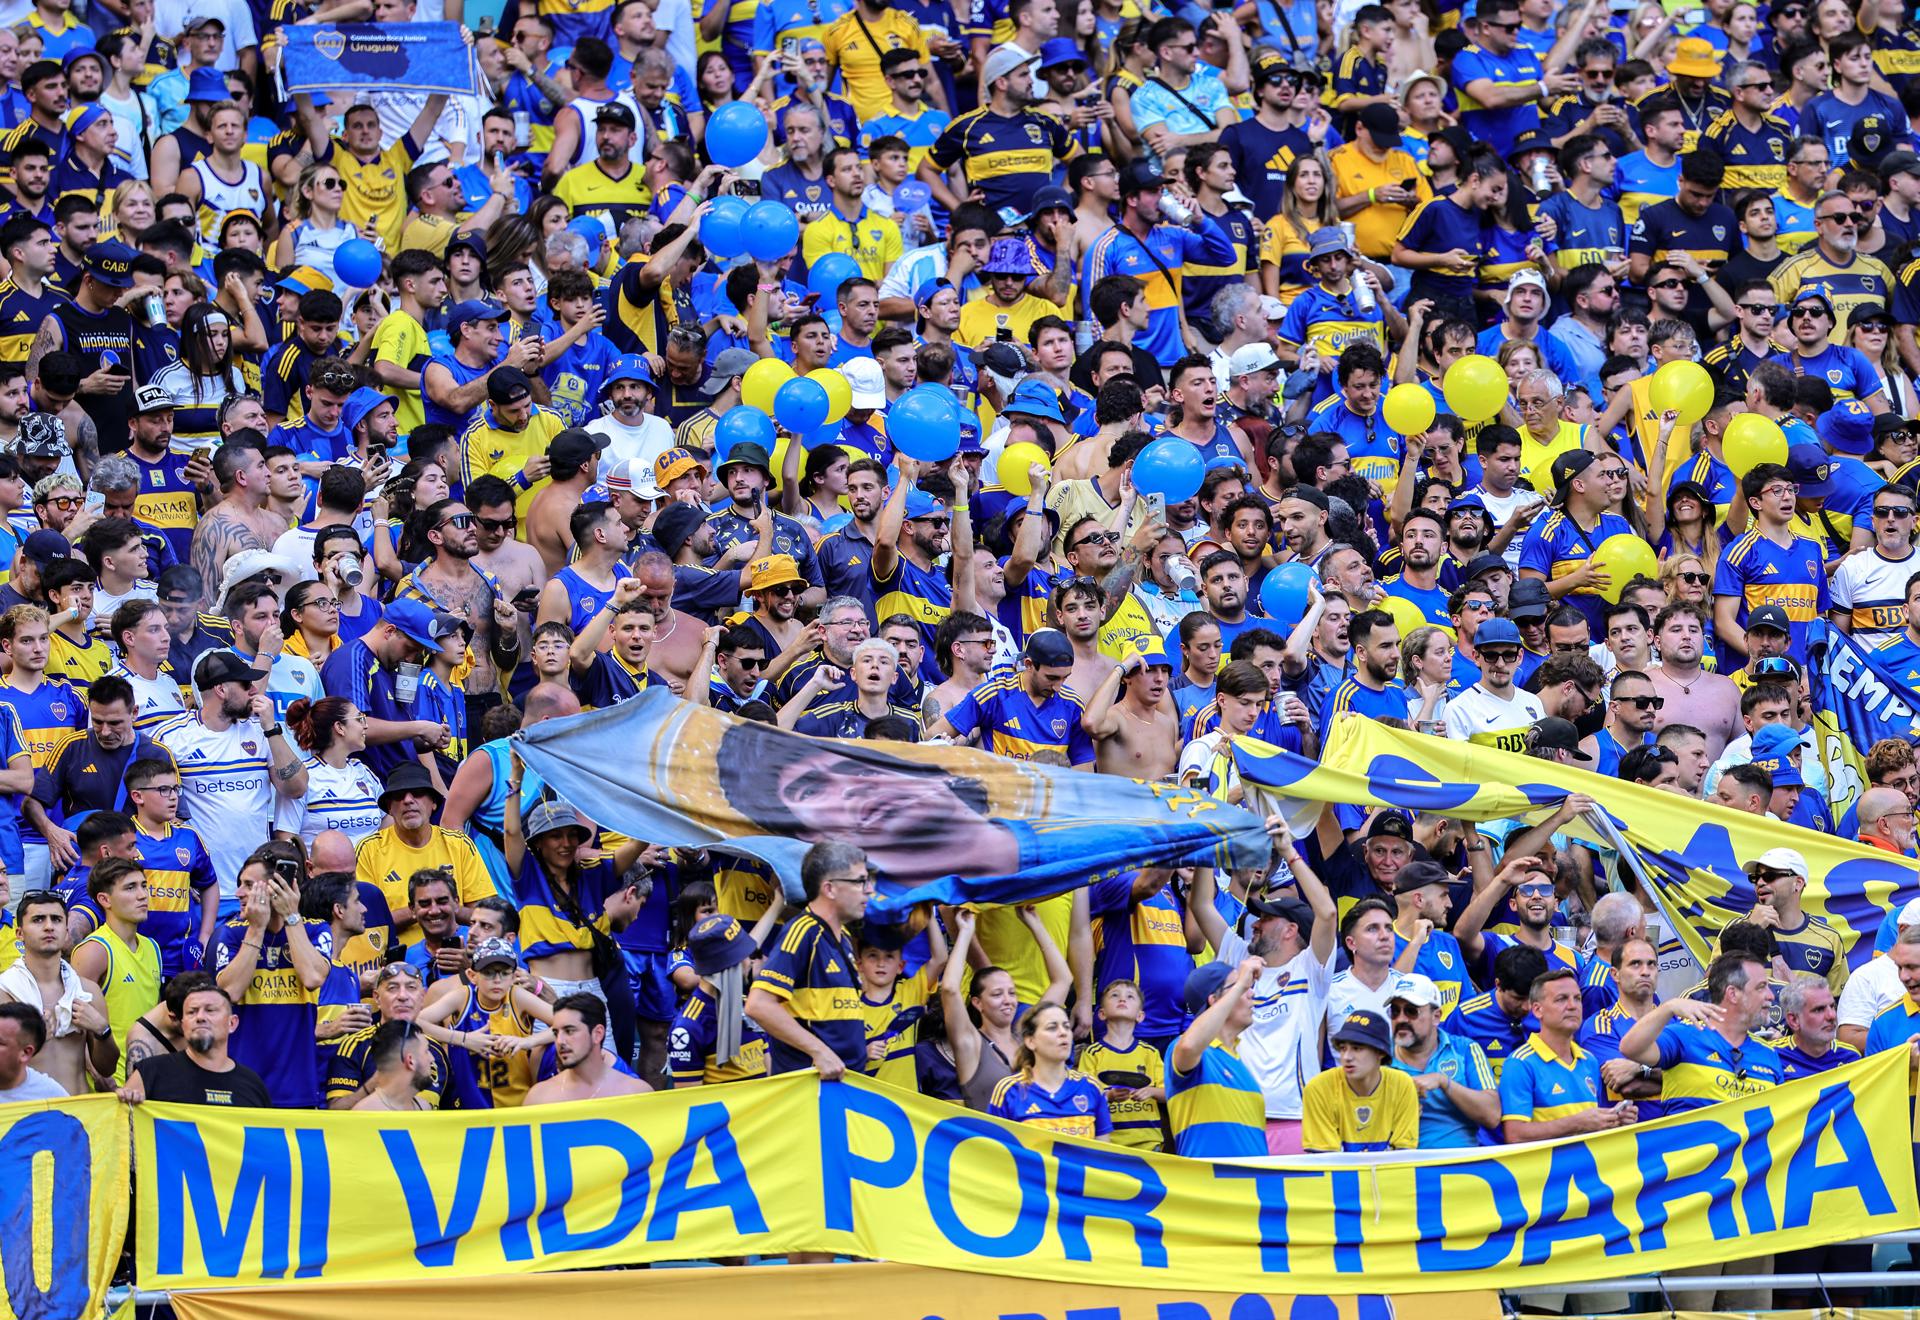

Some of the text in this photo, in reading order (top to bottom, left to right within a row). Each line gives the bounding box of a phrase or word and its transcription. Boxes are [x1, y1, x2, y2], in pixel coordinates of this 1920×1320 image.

[350, 43, 400, 54] Uruguay
[987, 156, 1046, 170] betsson
[102, 259, 129, 272] CABJ
[79, 336, 131, 352] WARRIORS
[145, 388, 169, 401] FILA
[658, 448, 692, 470] CAB
[139, 500, 189, 517] QATAR
[153, 512, 191, 522] AIRWAYS
[757, 561, 770, 573] 12
[195, 777, 263, 795] betsson
[327, 815, 382, 831] betsso
[148, 884, 188, 900] tsson
[1658, 957, 1696, 972] sson
[253, 975, 298, 991] QATAR
[263, 989, 299, 1000] AIRWAYS
[1256, 1002, 1288, 1020] sson
[477, 1061, 510, 1089] 12
[1107, 1102, 1154, 1114] etsson
[154, 1080, 1897, 1279] MI VIDA POR TI DARIA
